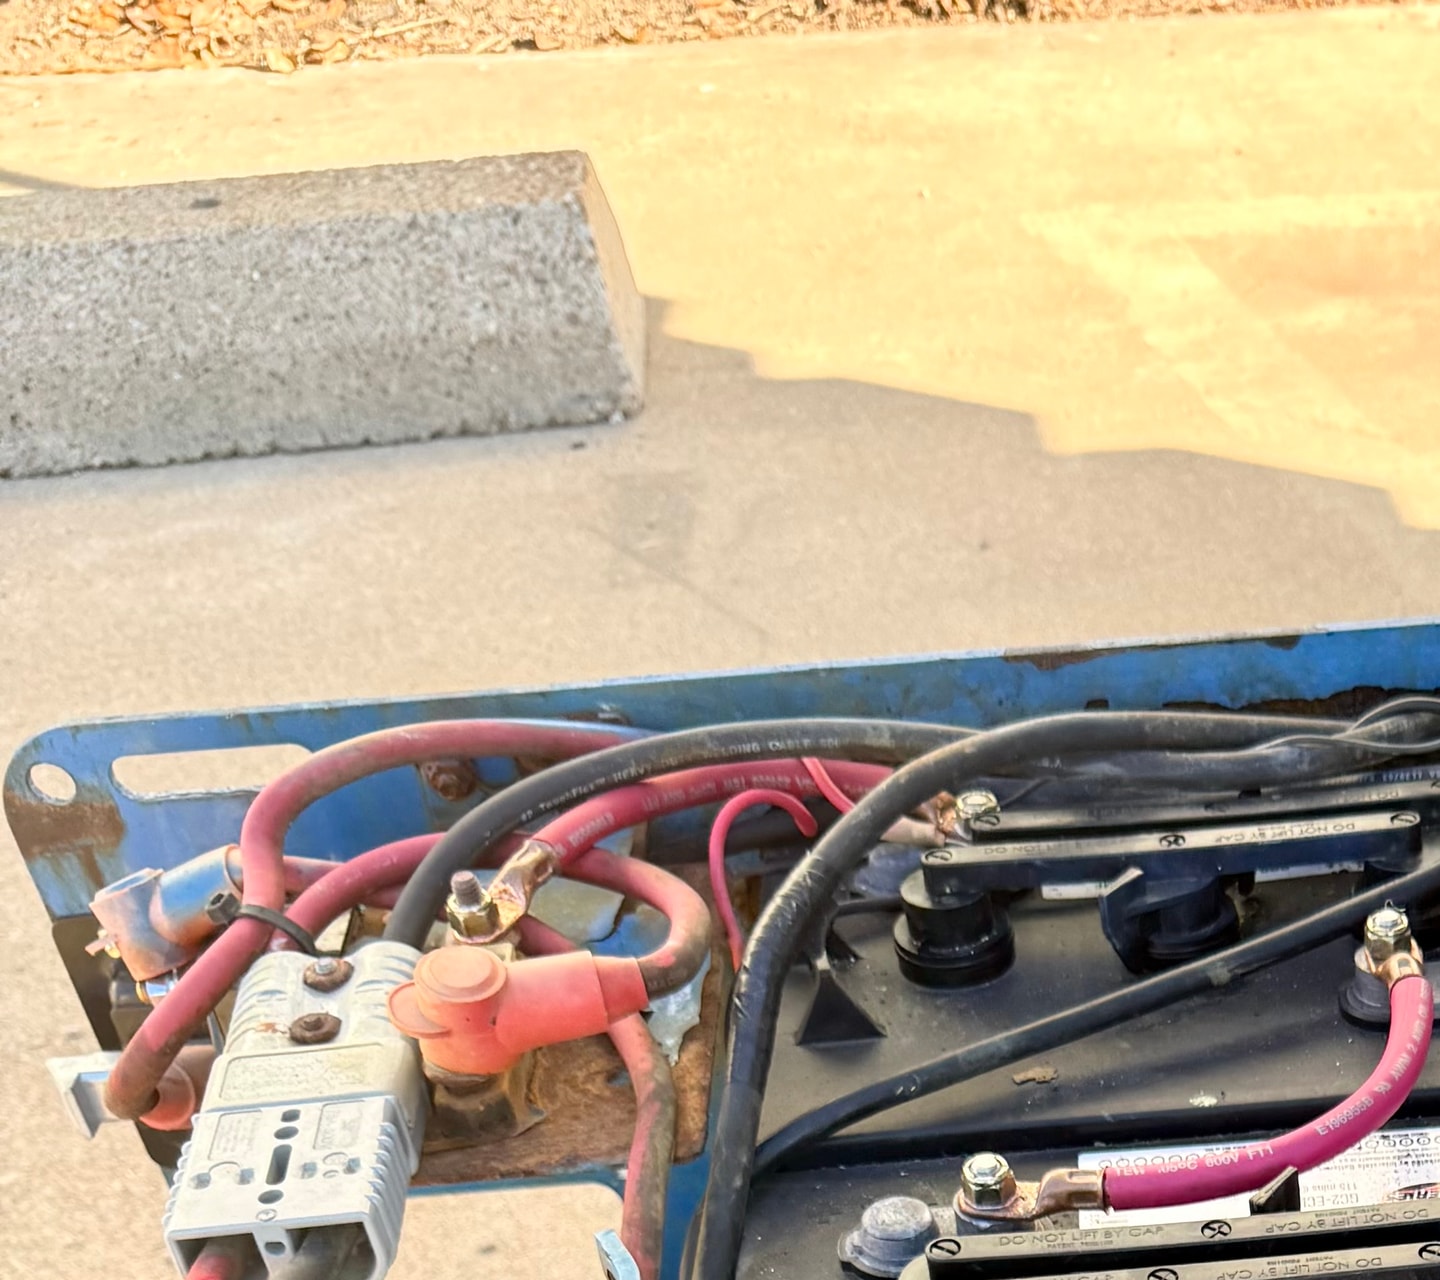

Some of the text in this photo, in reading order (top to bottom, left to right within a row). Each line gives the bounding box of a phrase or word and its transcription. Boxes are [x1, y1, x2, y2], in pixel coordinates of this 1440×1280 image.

[1115, 1166, 1146, 1177] TEW
[1204, 1152, 1240, 1168] 600V
[1266, 1208, 1429, 1234] DO NOT LIFT BY CAP
[999, 1226, 1164, 1247] DO NOT LIFT BY CAP
[1317, 1260, 1350, 1271] NOT
[1356, 1257, 1383, 1268] DO
[1258, 1267, 1278, 1277] BY
[1283, 1264, 1310, 1275] LIFT
